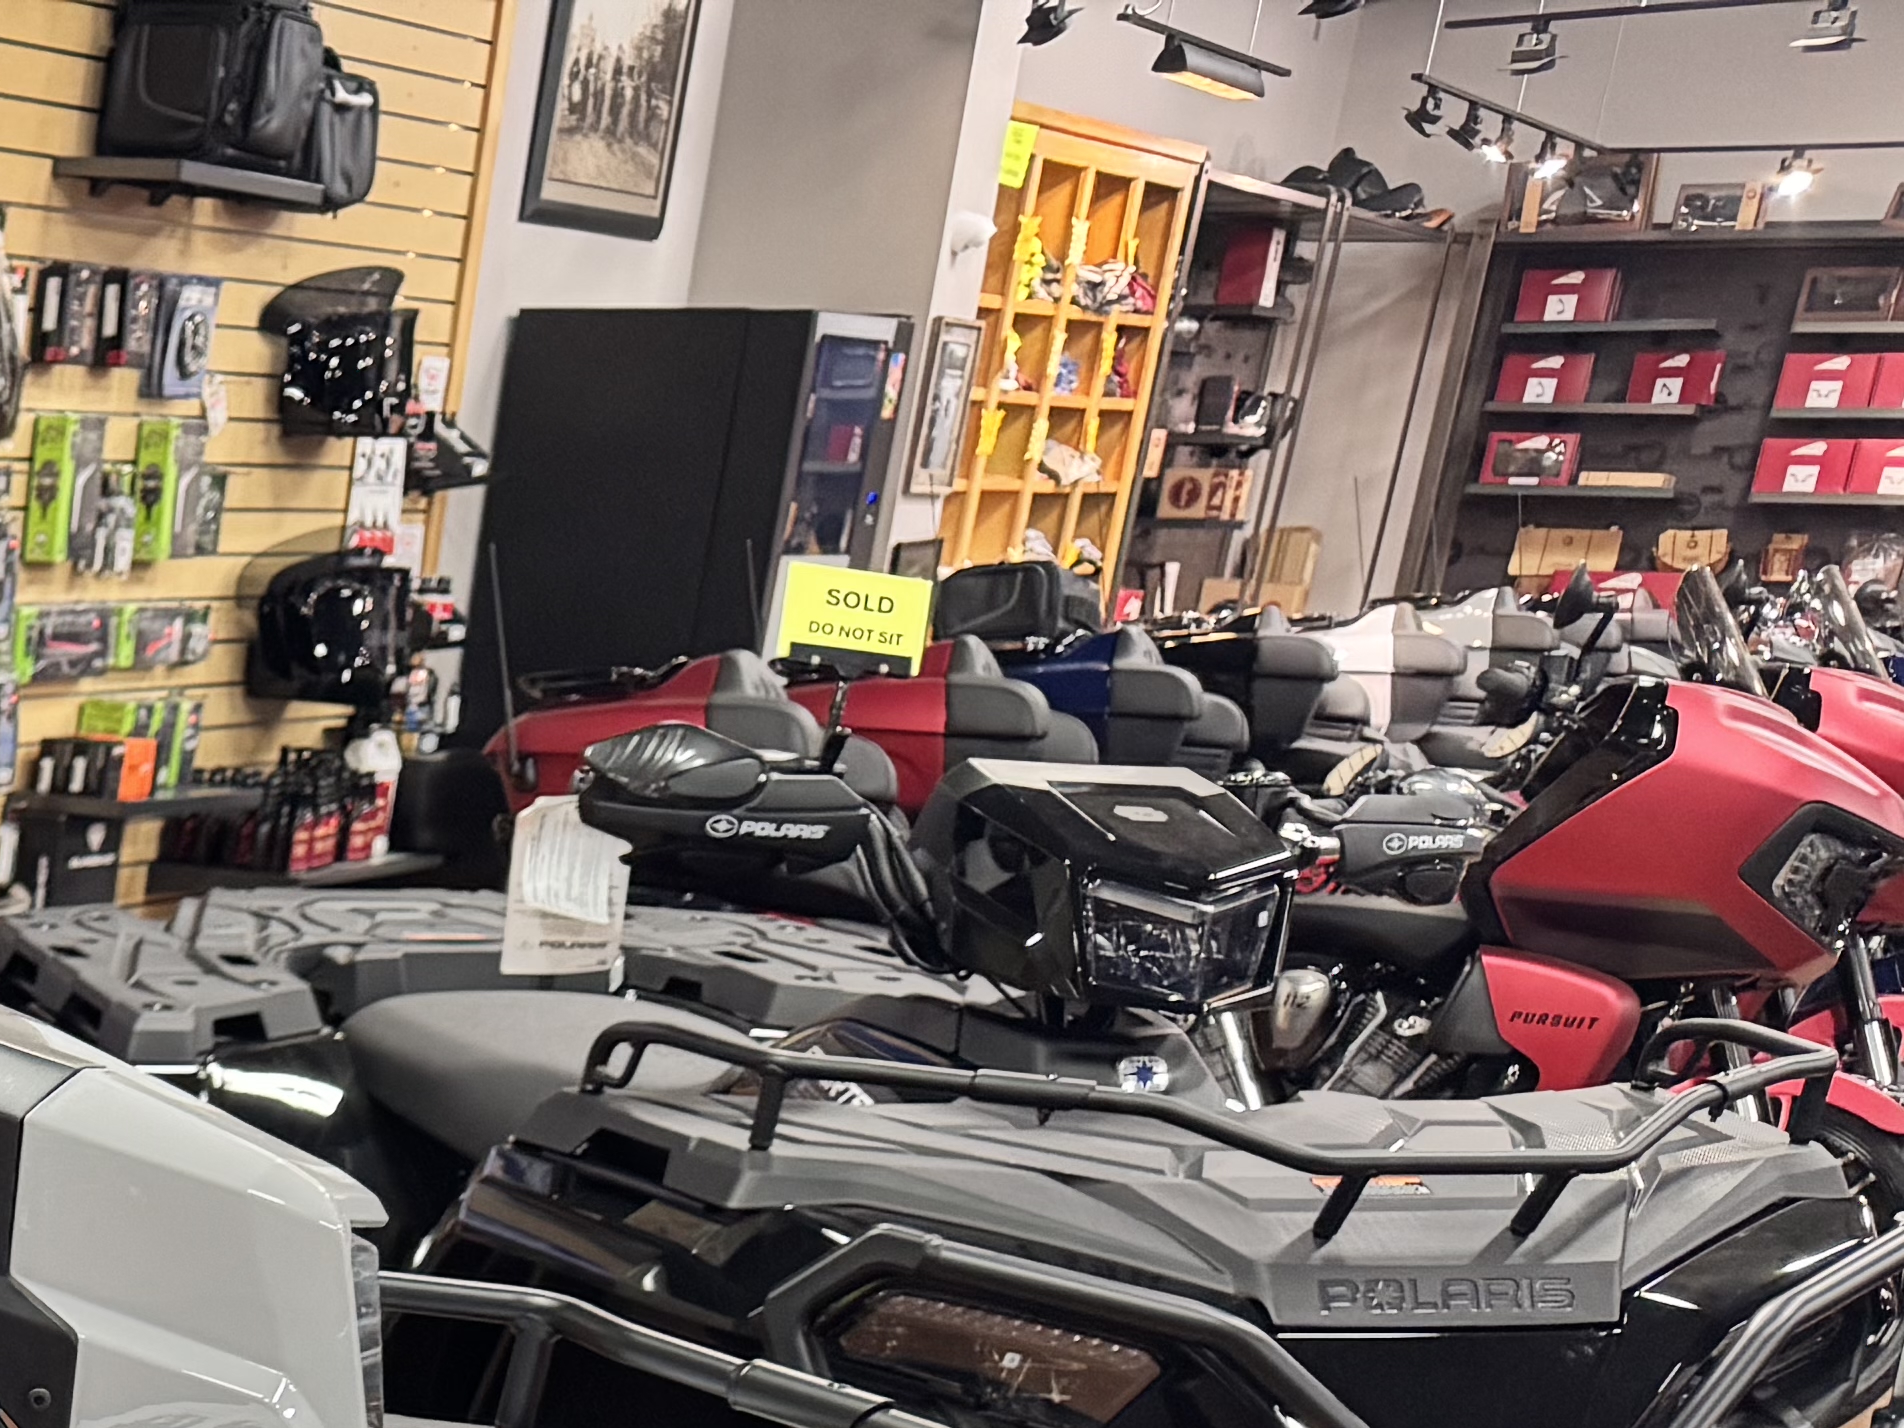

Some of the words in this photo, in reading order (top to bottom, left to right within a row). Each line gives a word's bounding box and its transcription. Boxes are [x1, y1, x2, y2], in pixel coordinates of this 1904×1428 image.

[826, 588, 894, 614] SOLD
[809, 620, 834, 636] DO
[838, 625, 875, 643] NOT
[877, 630, 904, 646] SIT
[738, 820, 832, 840] POLARIS
[1406, 833, 1466, 852] POLARIS
[1509, 1010, 1600, 1030] PURSUIT
[1317, 1276, 1576, 1316] POLARIS
